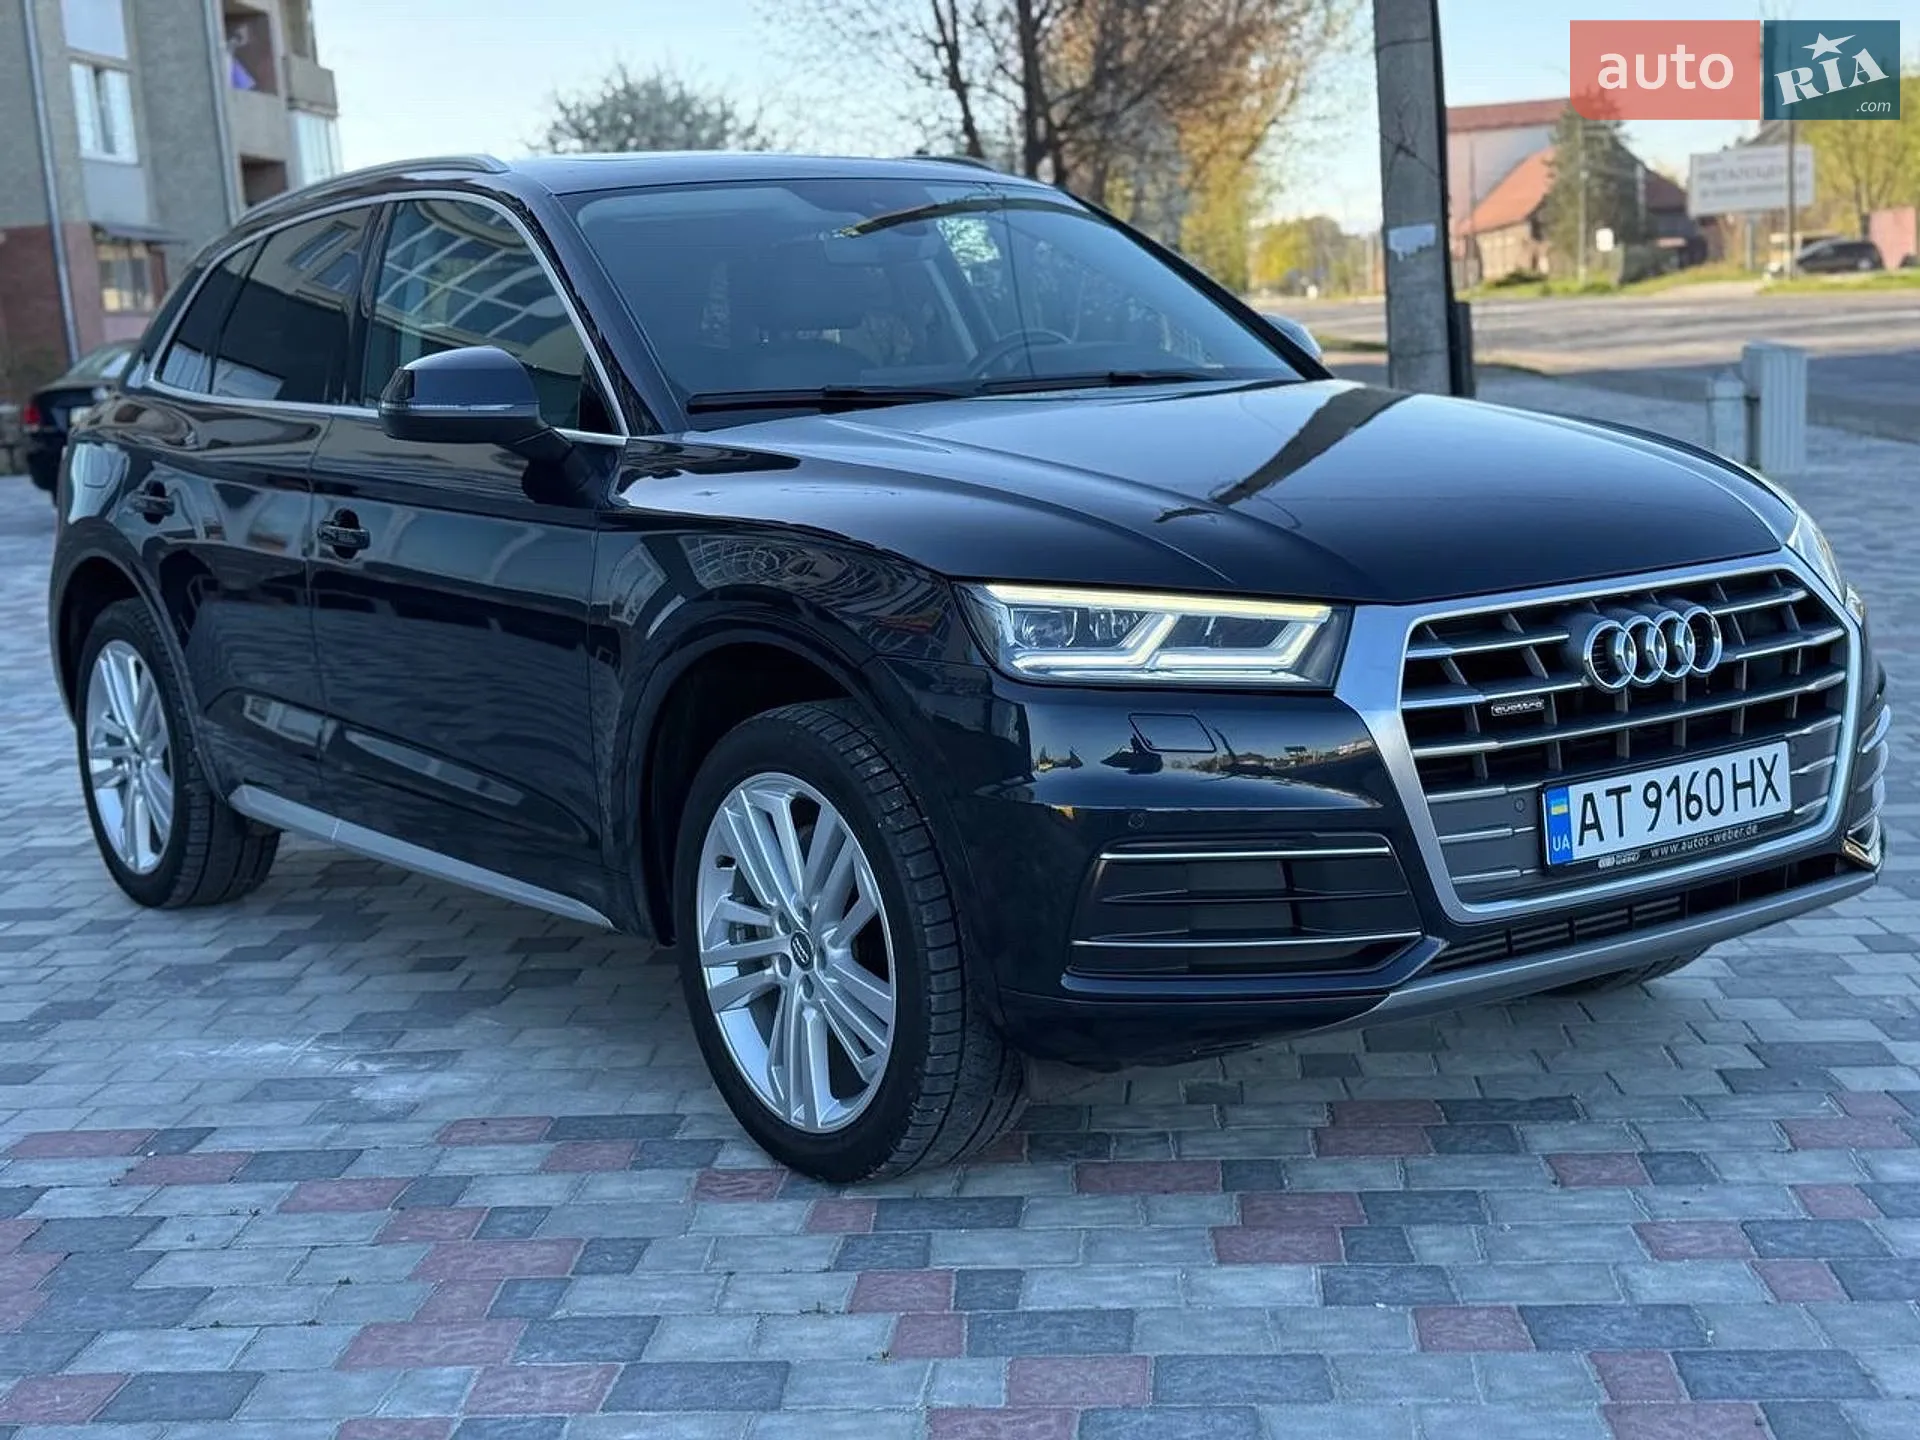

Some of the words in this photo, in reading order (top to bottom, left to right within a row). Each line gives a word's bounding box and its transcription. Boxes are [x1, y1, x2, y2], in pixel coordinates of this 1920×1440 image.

[1578, 785, 1632, 846] AT
[1642, 767, 1724, 832] 9160
[1731, 753, 1781, 812] HX
[1552, 835, 1571, 852] UA
